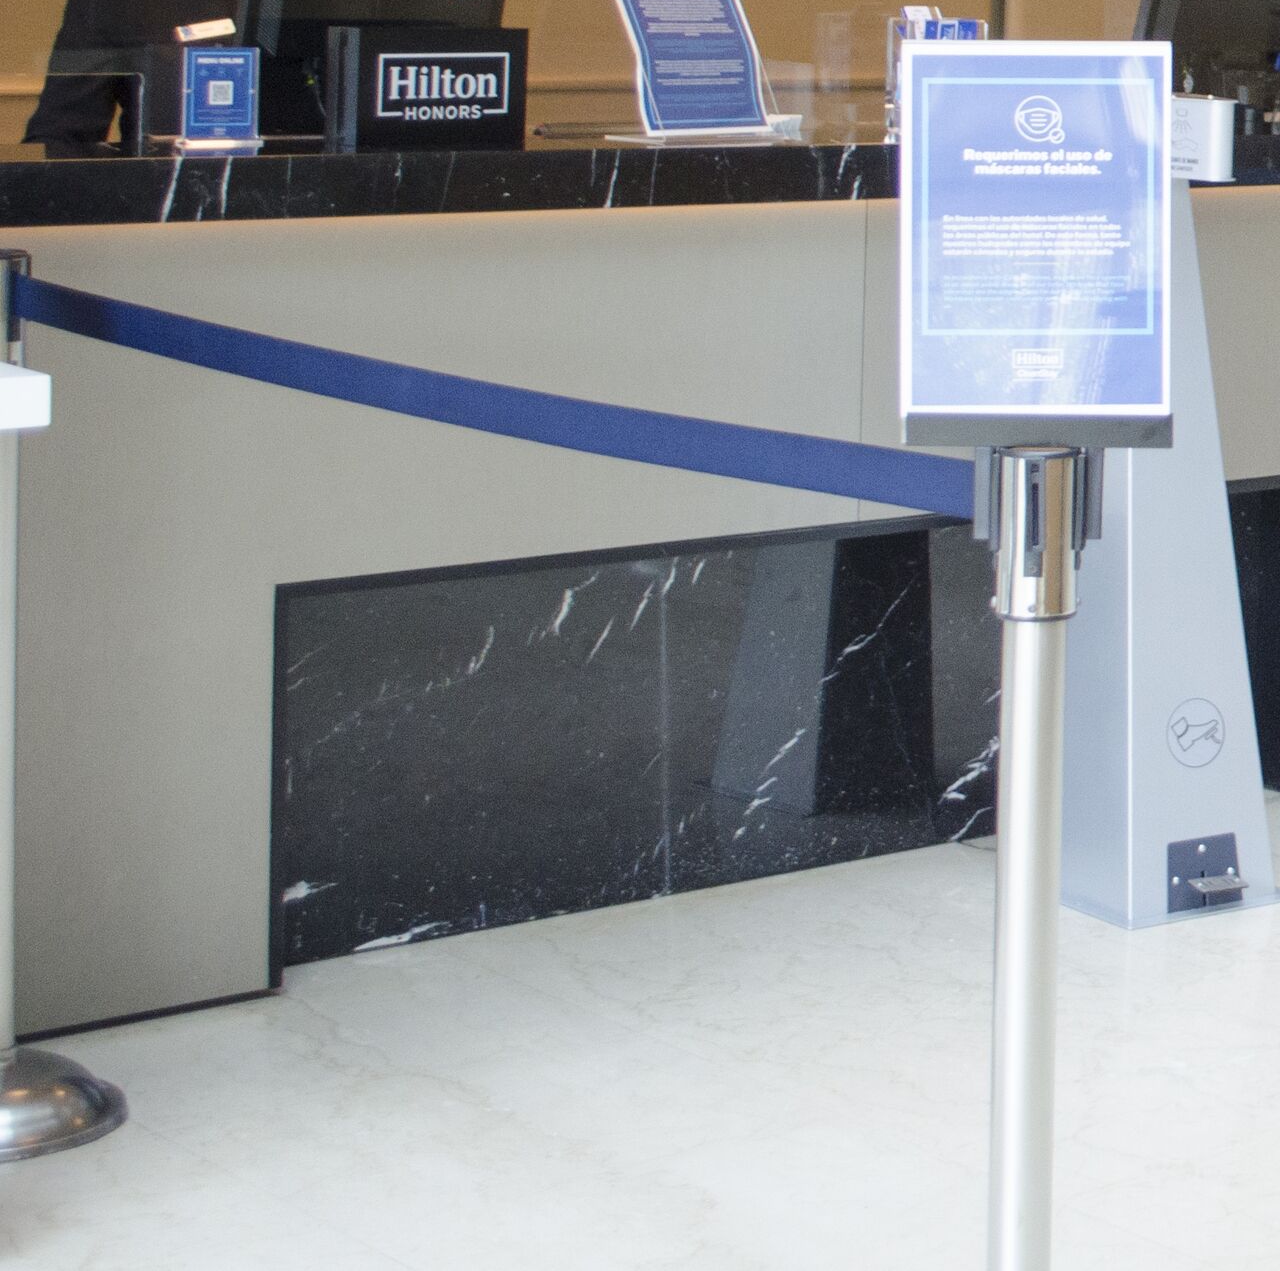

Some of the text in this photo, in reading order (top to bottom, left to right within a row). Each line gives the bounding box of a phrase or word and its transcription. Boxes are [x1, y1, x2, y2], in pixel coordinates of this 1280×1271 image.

[388, 65, 498, 100] Hilton
[404, 104, 482, 121] HONORS
[963, 148, 1113, 162] Requerimos el uso de
[974, 162, 1101, 175] máscaras faciales.
[1017, 352, 1058, 365] Hilton
